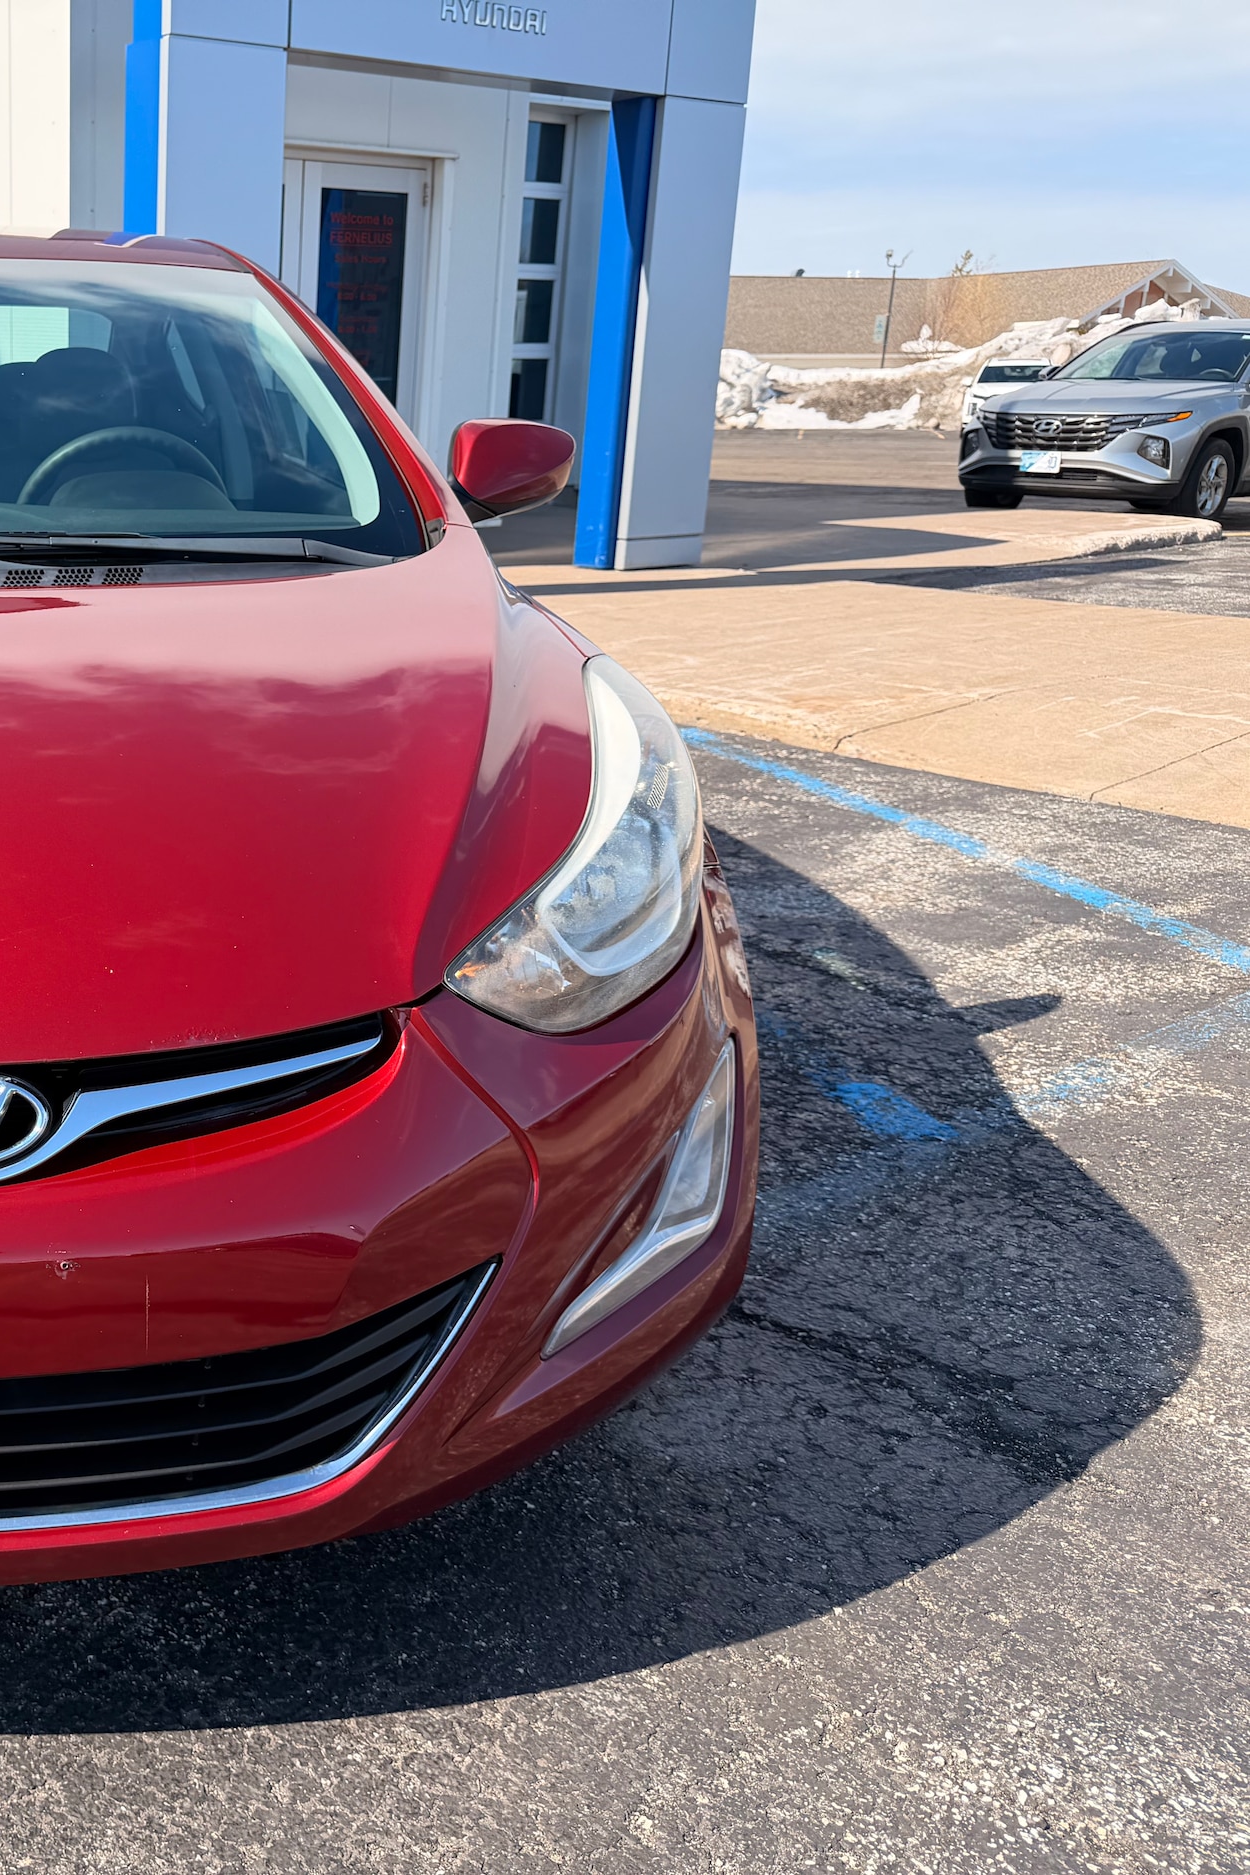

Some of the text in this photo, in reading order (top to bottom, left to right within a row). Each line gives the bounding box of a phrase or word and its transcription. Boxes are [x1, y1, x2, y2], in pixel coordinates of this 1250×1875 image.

[440, 0, 547, 35] HYUNDAI
[330, 211, 394, 226] Welcome to
[330, 231, 392, 244] FERNELIUS
